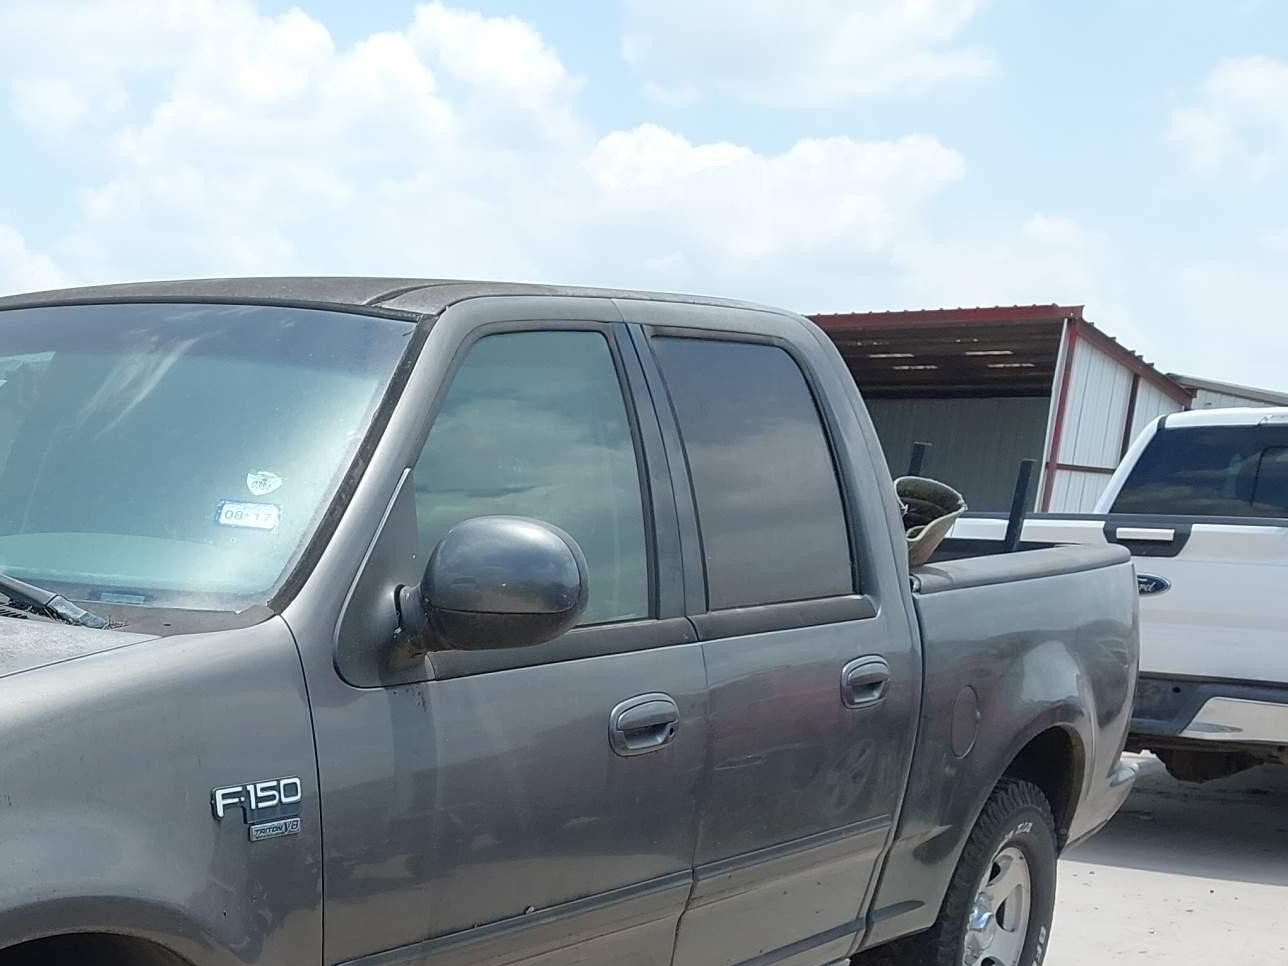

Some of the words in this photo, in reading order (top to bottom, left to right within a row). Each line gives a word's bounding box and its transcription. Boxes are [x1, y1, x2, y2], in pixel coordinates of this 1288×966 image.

[214, 776, 302, 818] F-150
[253, 825, 284, 839] TRITON
[283, 819, 300, 834] V8
